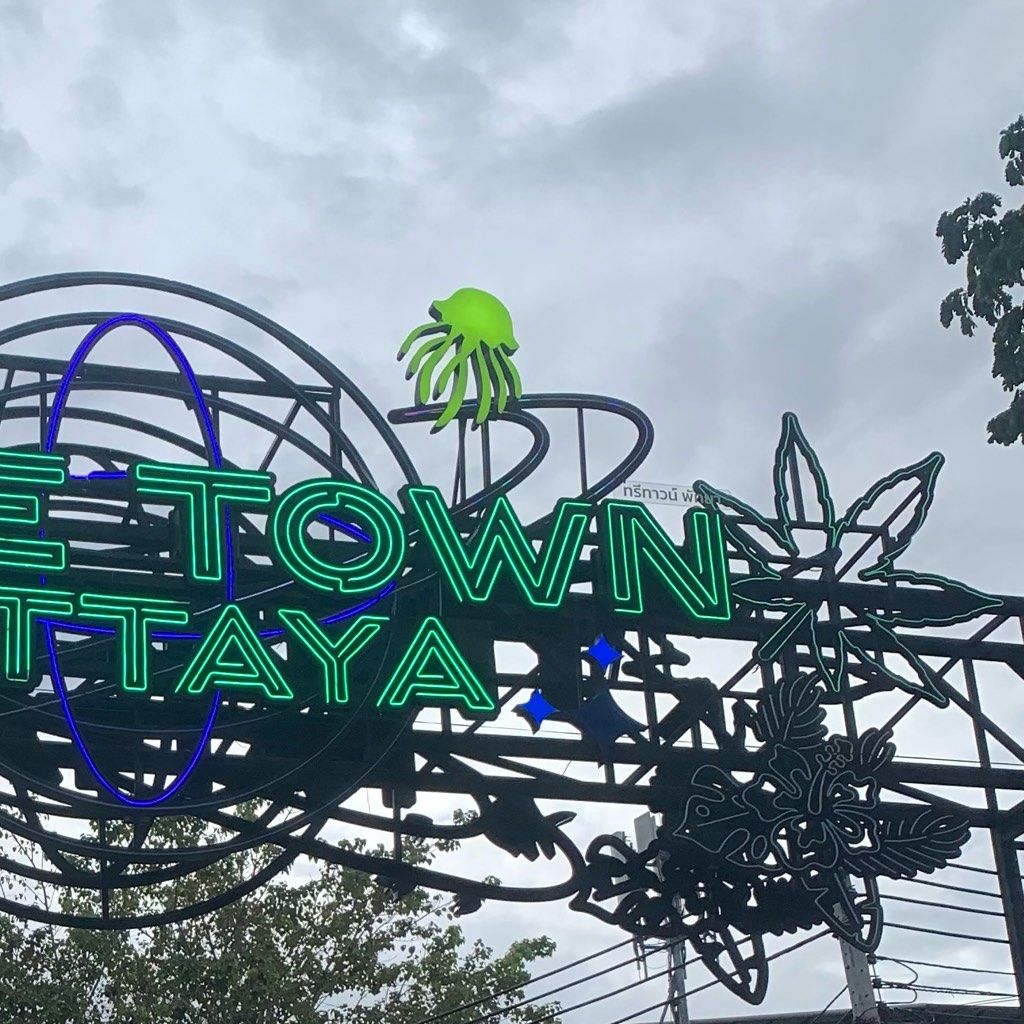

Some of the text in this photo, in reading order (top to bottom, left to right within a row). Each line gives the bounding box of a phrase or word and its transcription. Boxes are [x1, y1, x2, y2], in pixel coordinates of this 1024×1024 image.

[623, 484, 678, 502] ทรีทาวน์
[134, 462, 732, 622] TOWN
